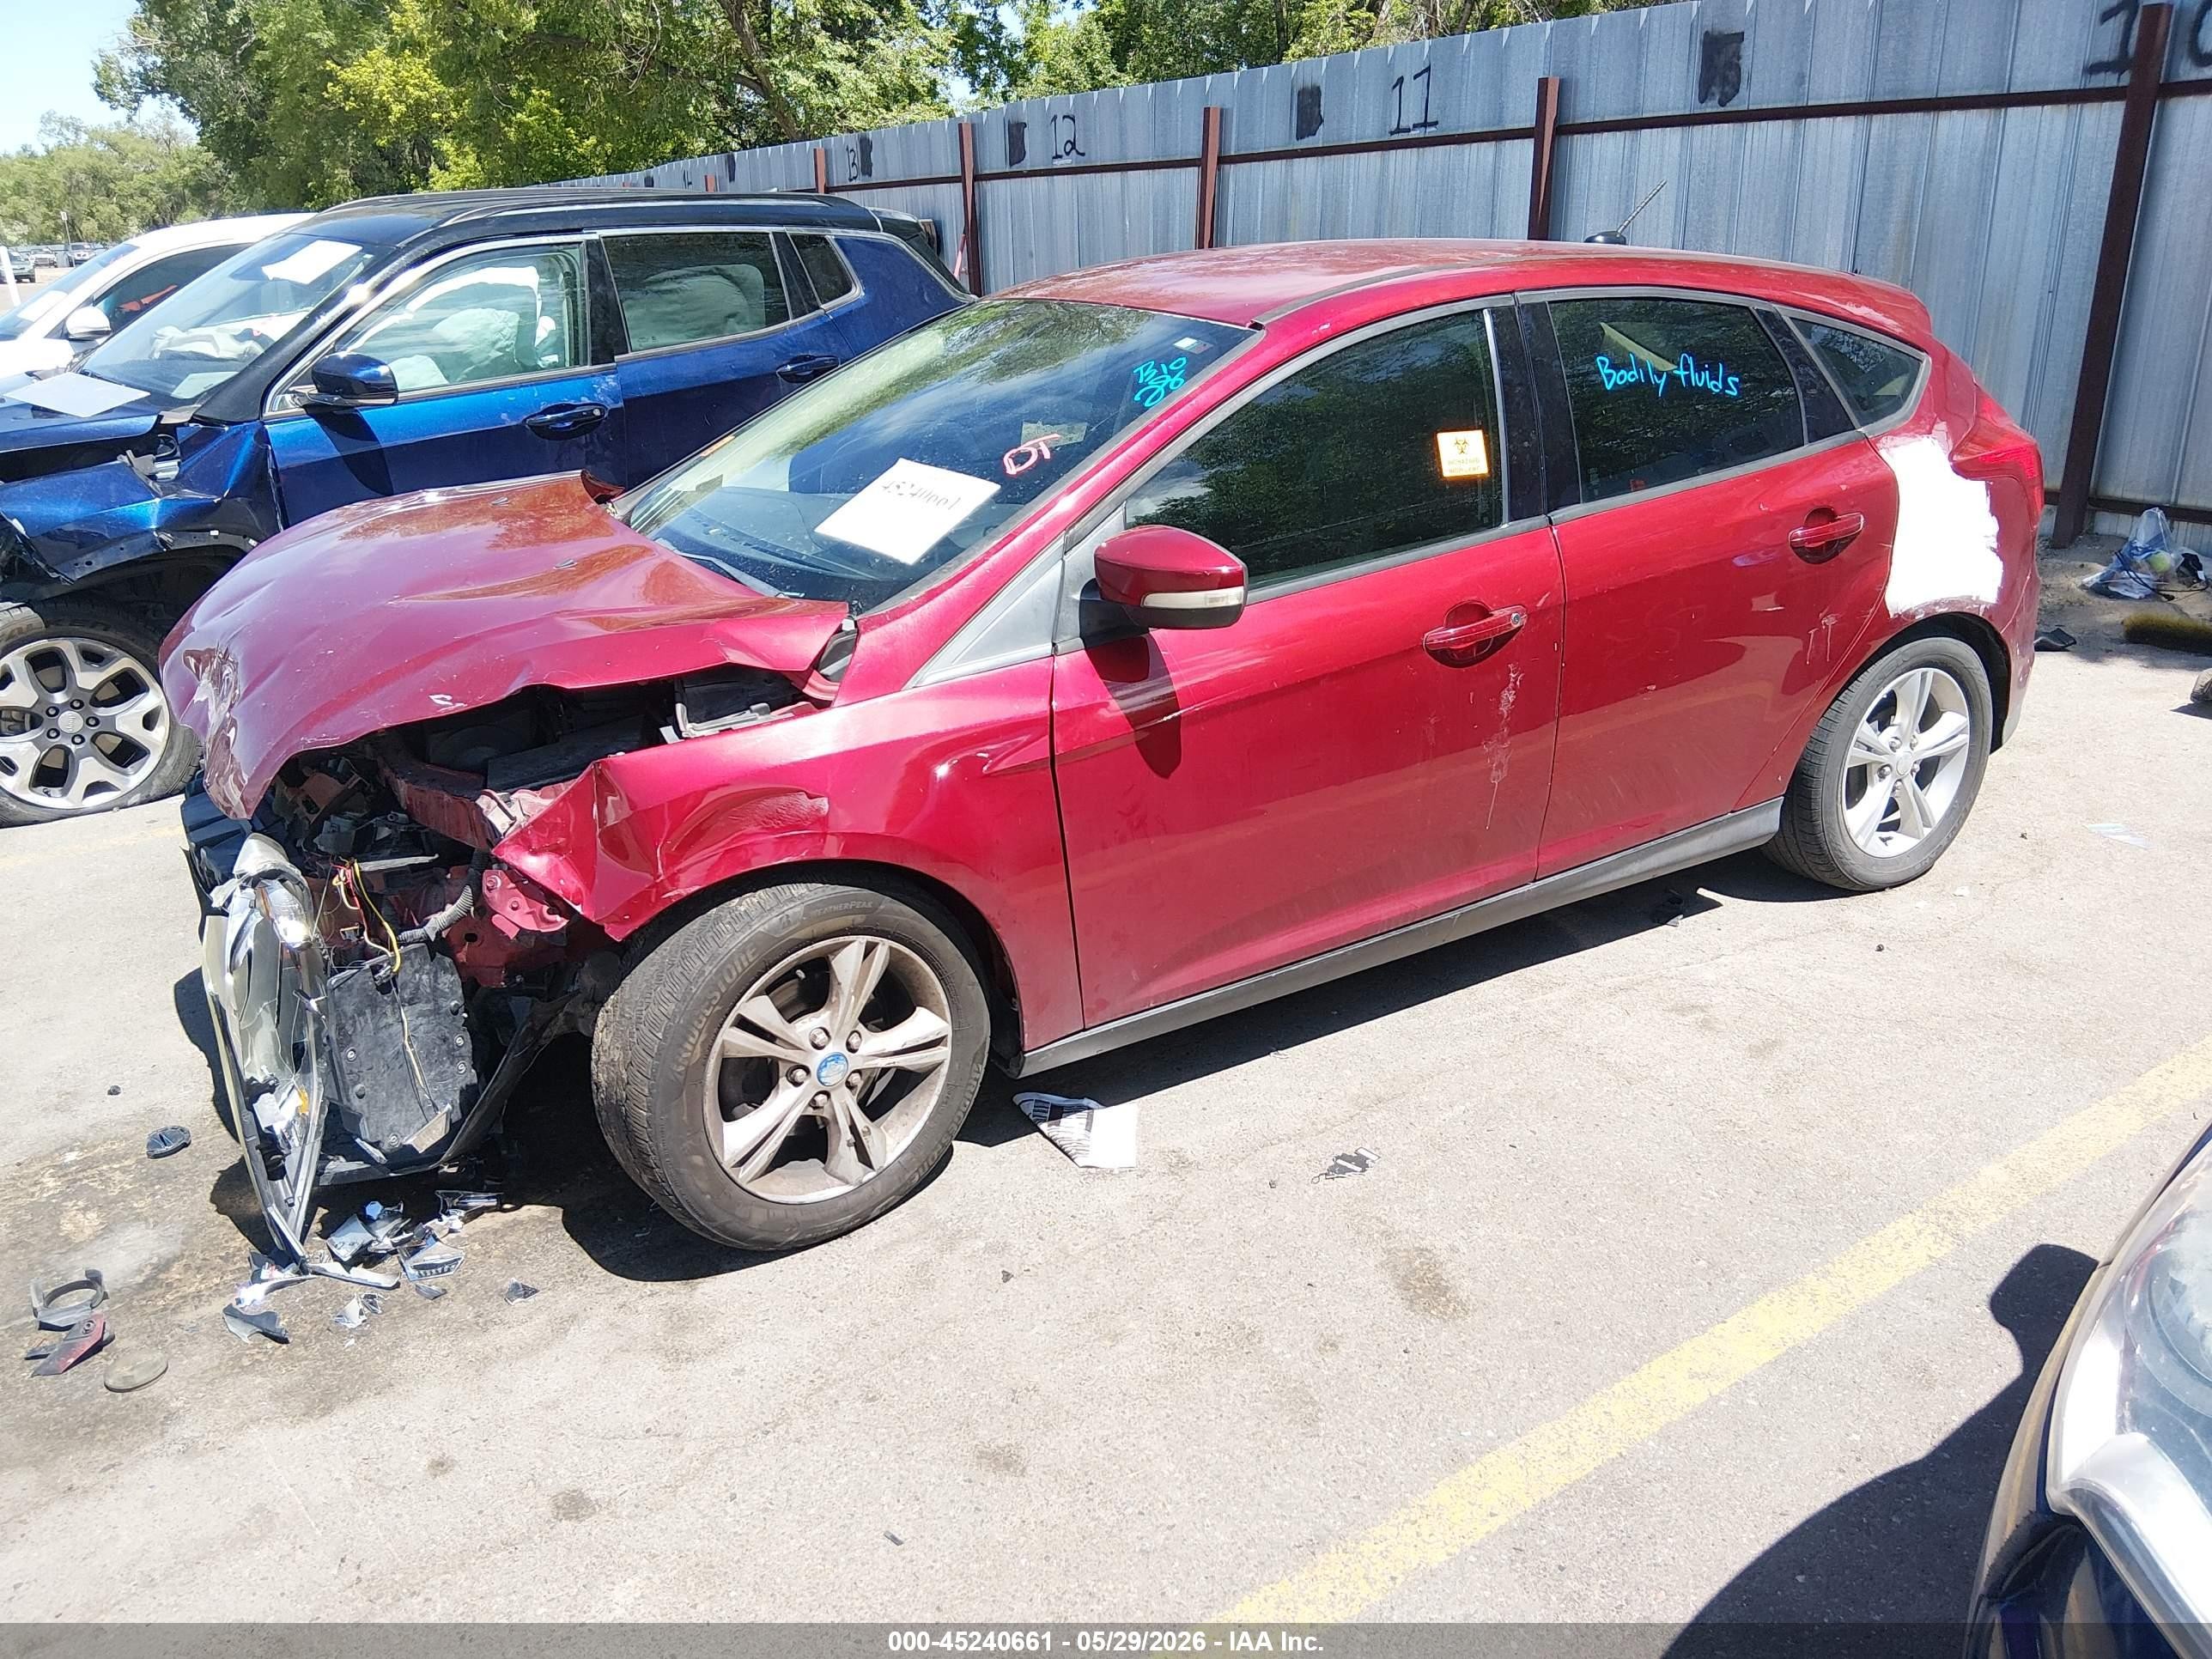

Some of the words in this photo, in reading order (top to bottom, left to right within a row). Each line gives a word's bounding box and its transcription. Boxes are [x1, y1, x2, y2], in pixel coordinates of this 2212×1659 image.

[1388, 64, 1439, 136] 11
[1050, 113, 1086, 159] 12
[1595, 352, 1667, 398] Bodily
[1673, 352, 1740, 397] fluids
